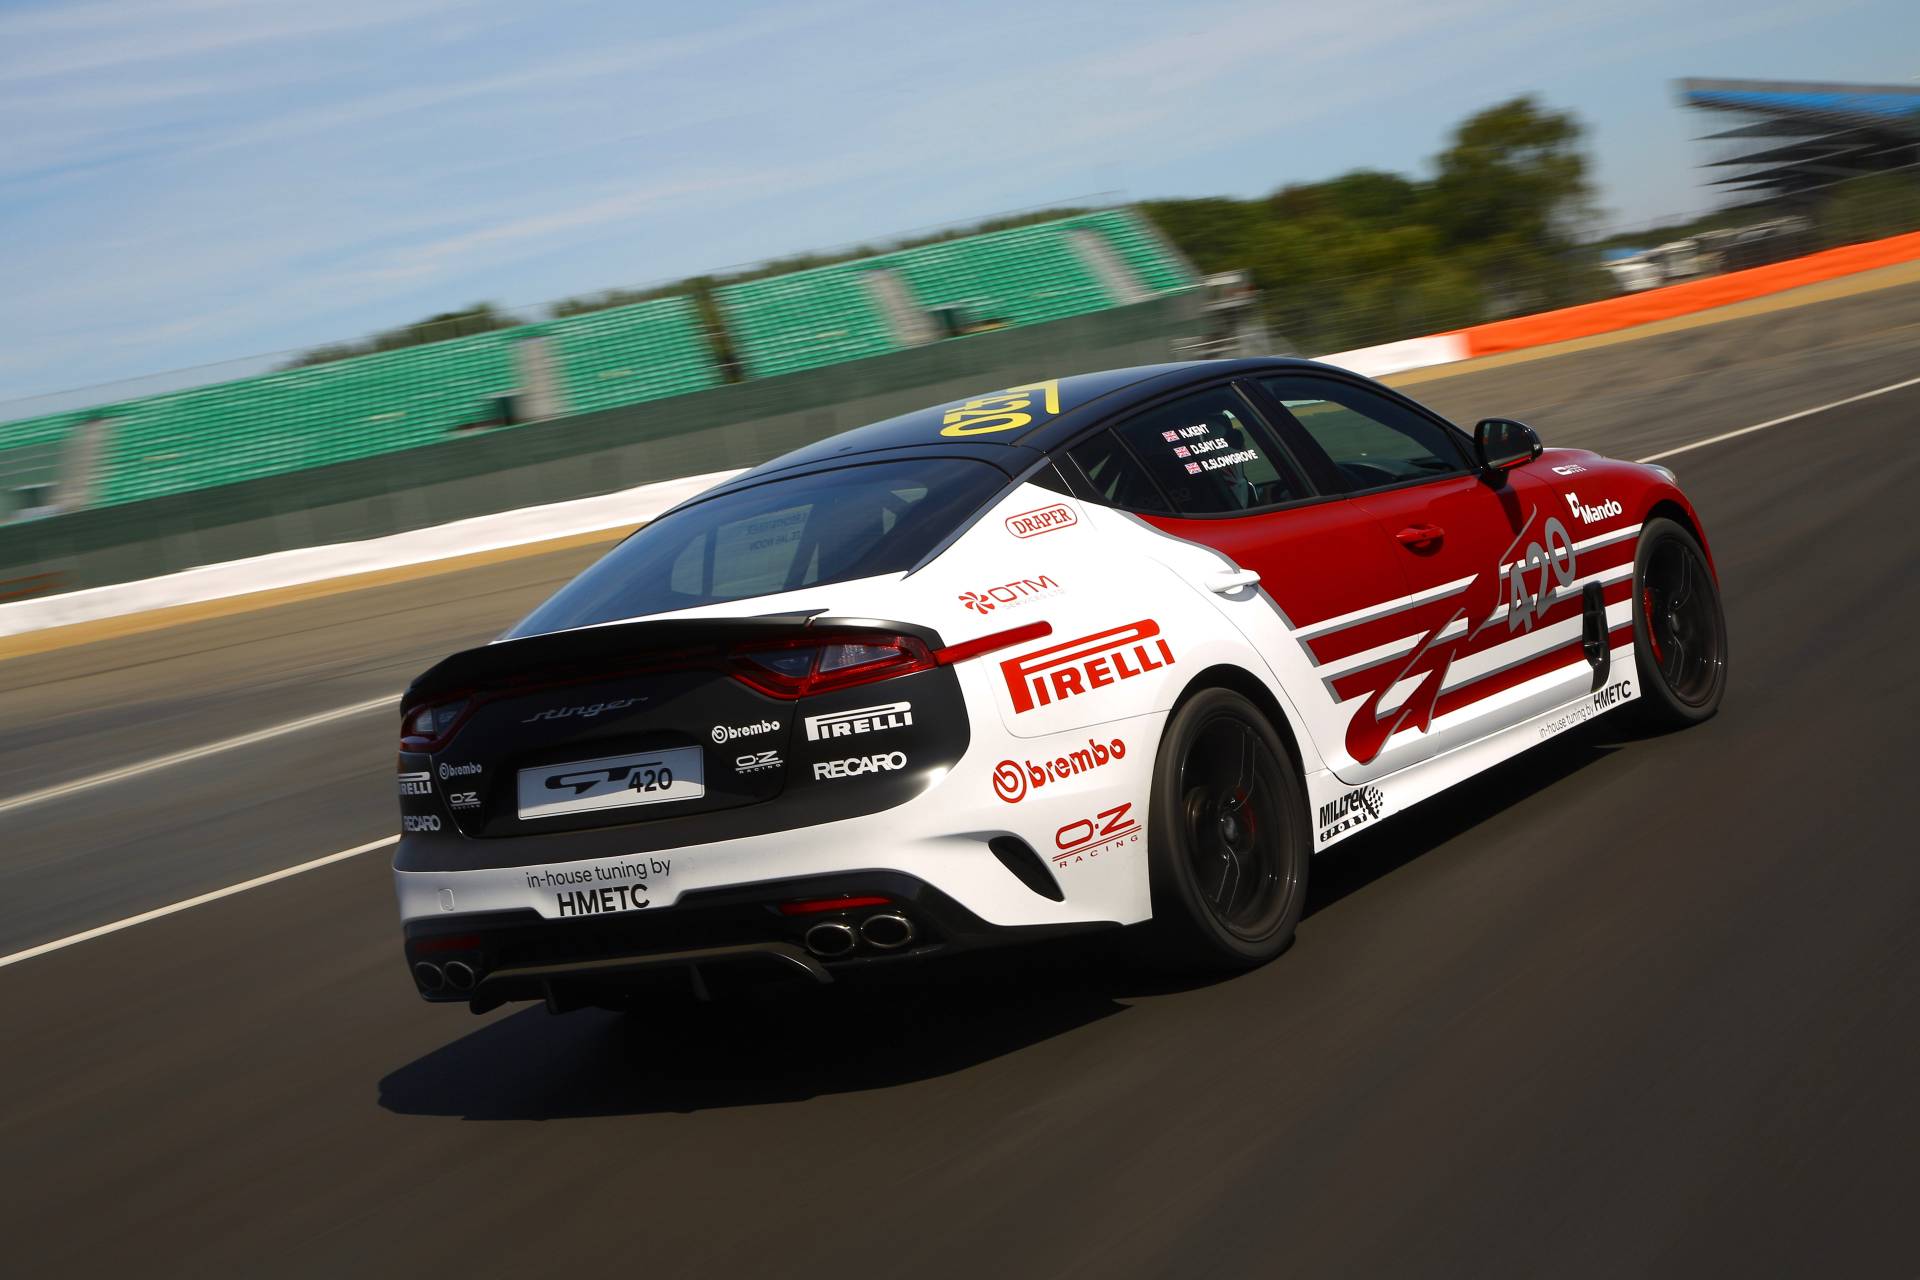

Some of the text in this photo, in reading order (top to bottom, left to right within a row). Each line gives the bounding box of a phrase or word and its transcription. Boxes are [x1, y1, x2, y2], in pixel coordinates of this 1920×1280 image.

[1179, 423, 1210, 439] N.KENT
[1190, 437, 1229, 455] D.SAYLES
[1201, 449, 1259, 471] R.SLOWGROVE
[1012, 507, 1073, 534] DRAPER
[1580, 498, 1623, 524] Mando
[987, 575, 1059, 602] OTM
[1508, 516, 1577, 633] 420
[999, 618, 1176, 714] PIRELLI
[1593, 680, 1632, 711] HMETC
[521, 697, 649, 724] stinger
[804, 701, 913, 741] PIRELLI
[728, 719, 781, 739] brembo
[449, 762, 482, 776] brembo
[813, 750, 908, 781] RECARO
[1025, 738, 1126, 789] brembo
[629, 767, 673, 793] 420
[1321, 813, 1367, 842] SPORT
[1059, 834, 1139, 868] RACING
[526, 858, 672, 888] in-house tuning by
[556, 883, 650, 917] HMETC
